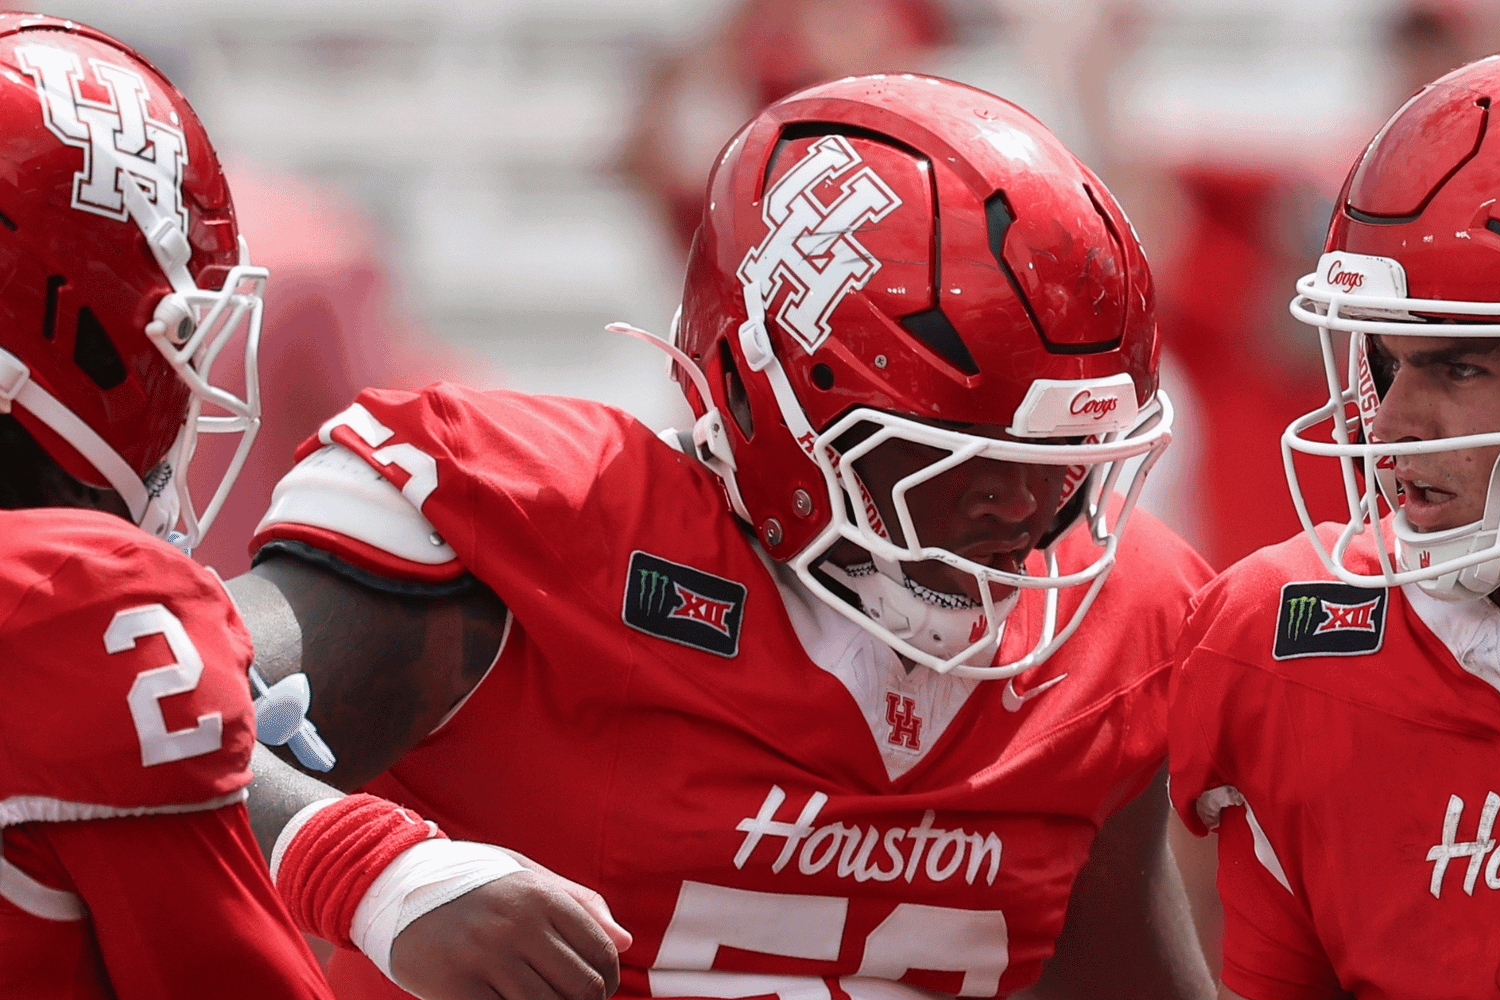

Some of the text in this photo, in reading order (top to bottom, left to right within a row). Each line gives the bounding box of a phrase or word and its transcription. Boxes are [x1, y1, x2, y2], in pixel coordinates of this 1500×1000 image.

[14, 42, 189, 232] UH
[737, 135, 902, 354] UH
[1326, 260, 1364, 293] Coogs
[1070, 390, 1118, 420] Coogs
[103, 603, 223, 768] 2
[885, 691, 922, 750] UH
[733, 783, 1003, 887] Houston
